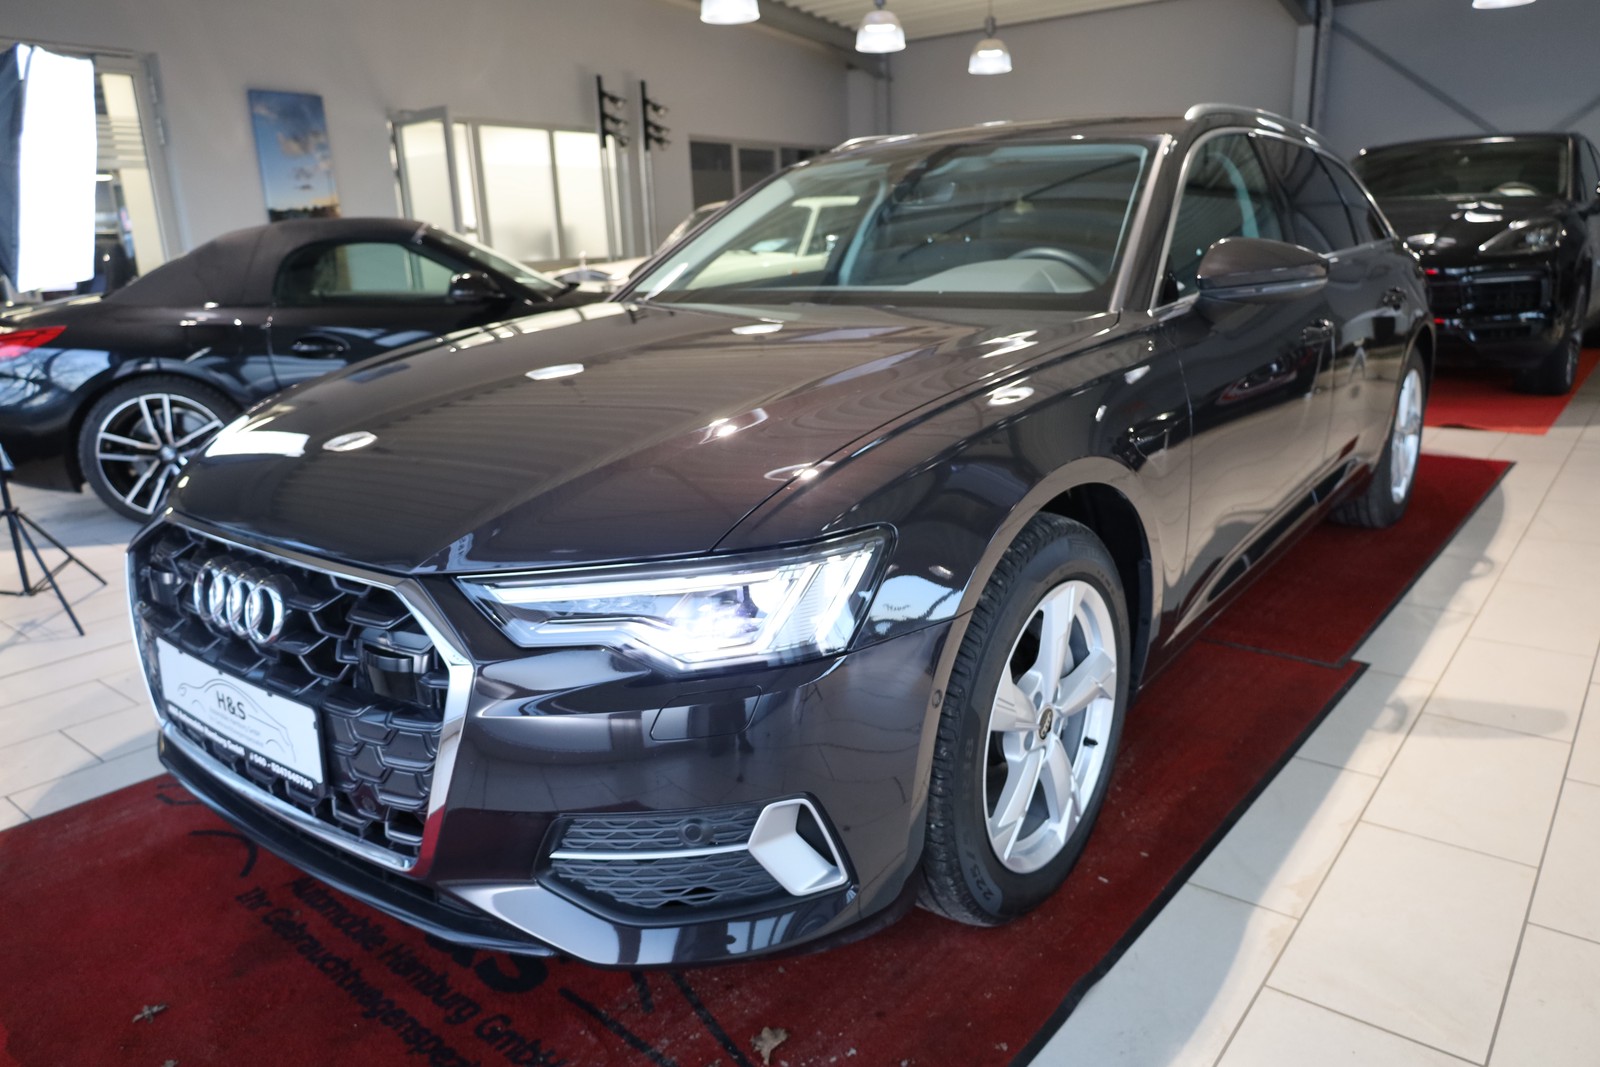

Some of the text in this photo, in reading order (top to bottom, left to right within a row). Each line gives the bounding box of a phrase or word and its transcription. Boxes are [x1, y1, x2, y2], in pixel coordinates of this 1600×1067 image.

[216, 690, 246, 720] H&S
[234, 886, 273, 911] Ihr
[281, 876, 389, 951] Automobile
[378, 943, 483, 1026] Hamburg
